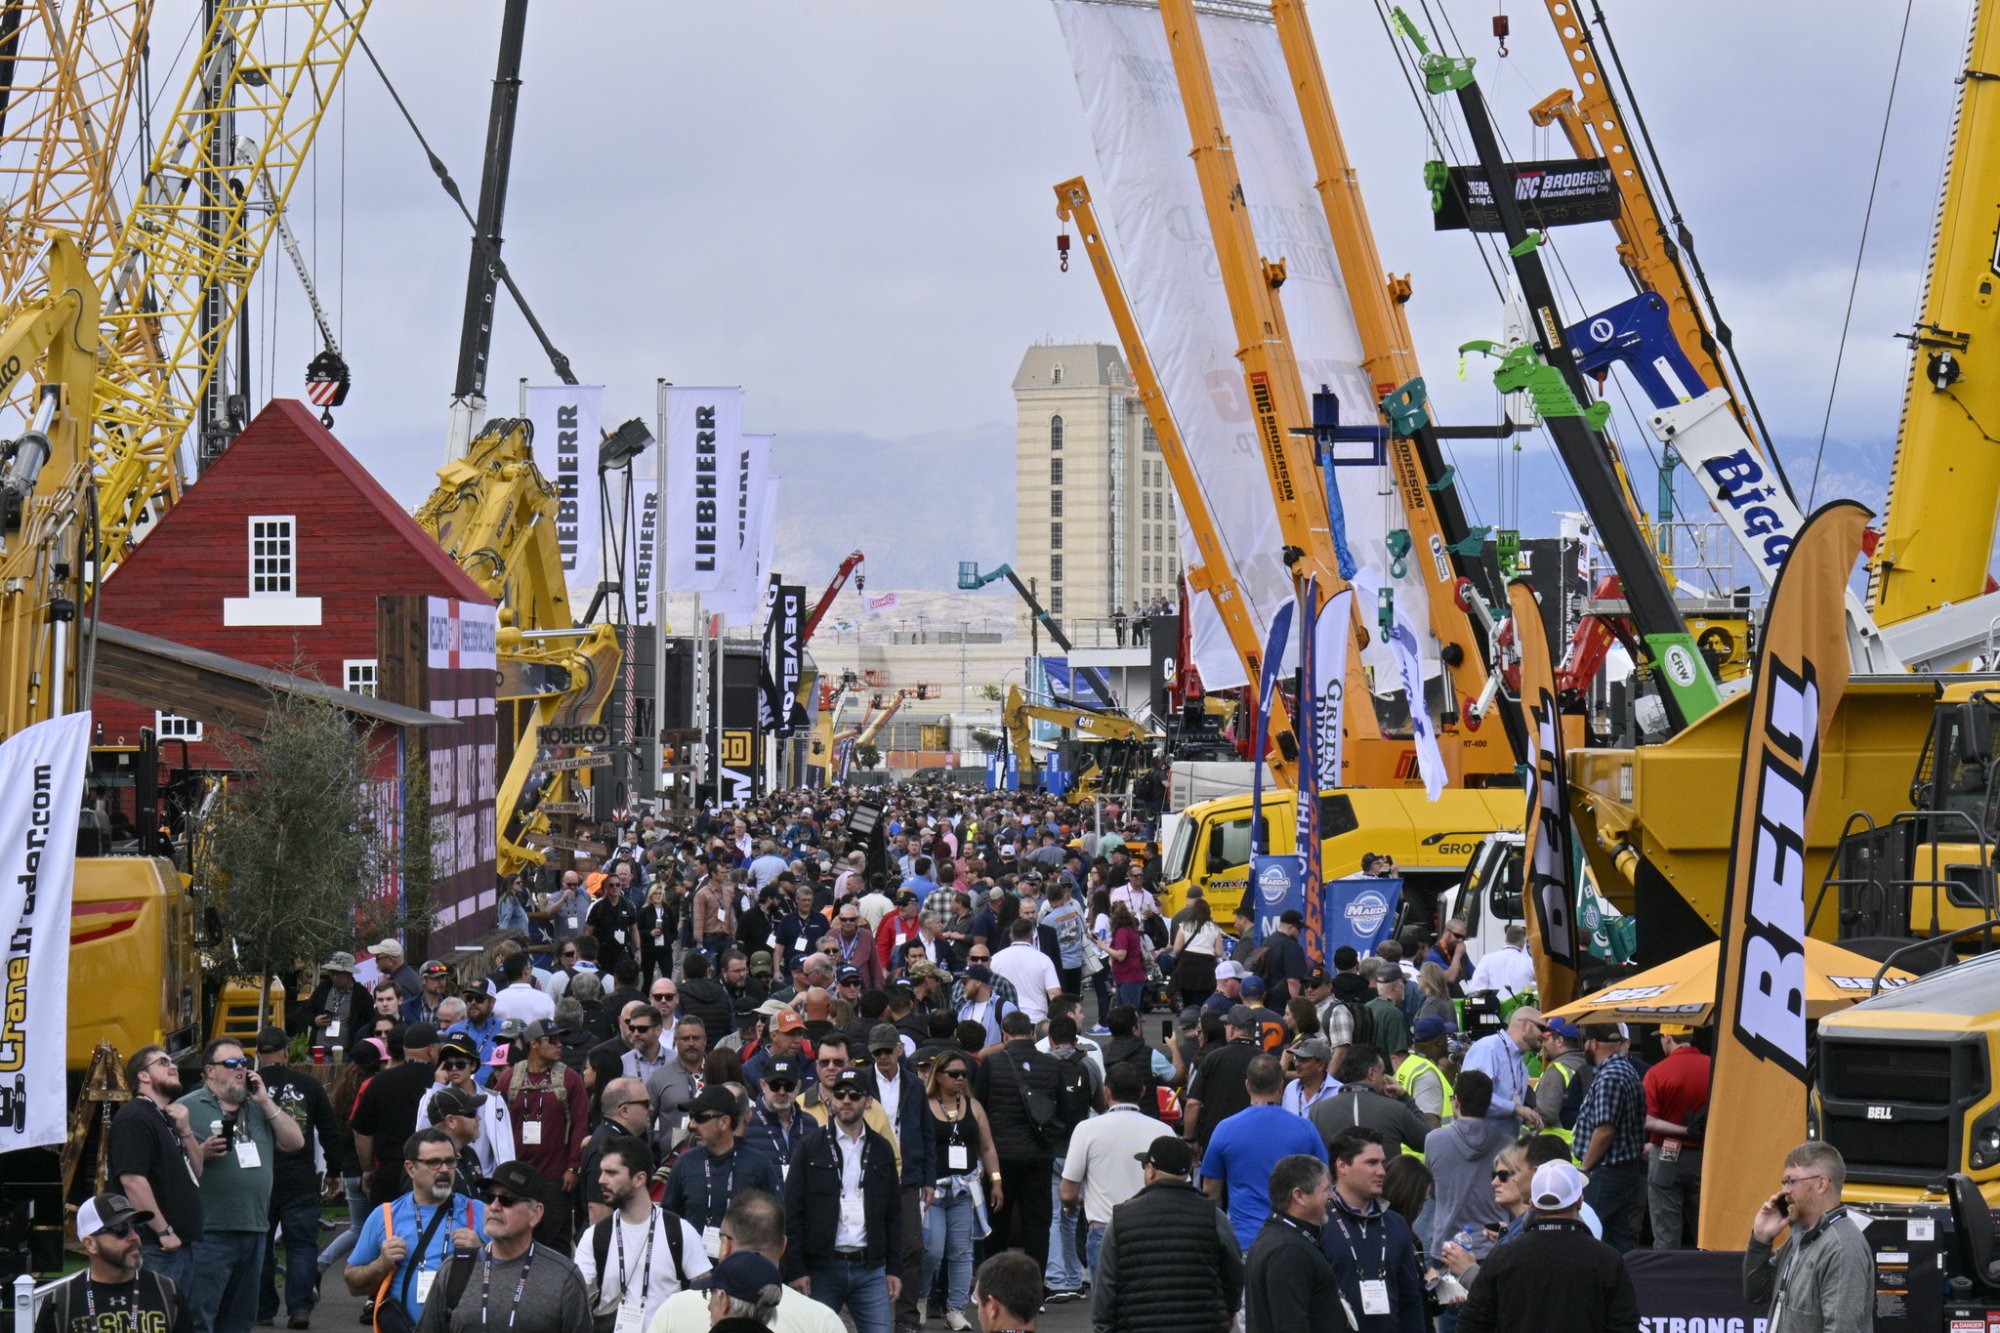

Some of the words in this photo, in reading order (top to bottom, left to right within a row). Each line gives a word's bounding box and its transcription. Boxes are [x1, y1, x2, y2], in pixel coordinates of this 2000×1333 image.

[1542, 168, 1611, 189] BRODERSON
[1540, 185, 1596, 199] Manufacturing
[1266, 415, 1295, 502] BRODERSON
[557, 404, 578, 571] LIEBHERR
[695, 404, 717, 572] LIEBHERR
[636, 492, 658, 614] LIEBHERR
[1671, 652, 1690, 680] CRW
[1079, 717, 1095, 729] CAT
[540, 726, 606, 745] KOBELCO
[541, 761, 562, 771] HEAVY
[565, 757, 605, 768] EXCAVATORS
[1296, 790, 1309, 839] THE
[1734, 660, 1818, 1073] BELL
[1259, 876, 1290, 887] MAEDA
[1347, 904, 1389, 916] MAEDA
[775, 1063, 788, 1071] CAT
[842, 1071, 856, 1079] CAT
[1867, 1106, 1892, 1119] BELL
[1638, 1317, 1746, 1333] STRONG
